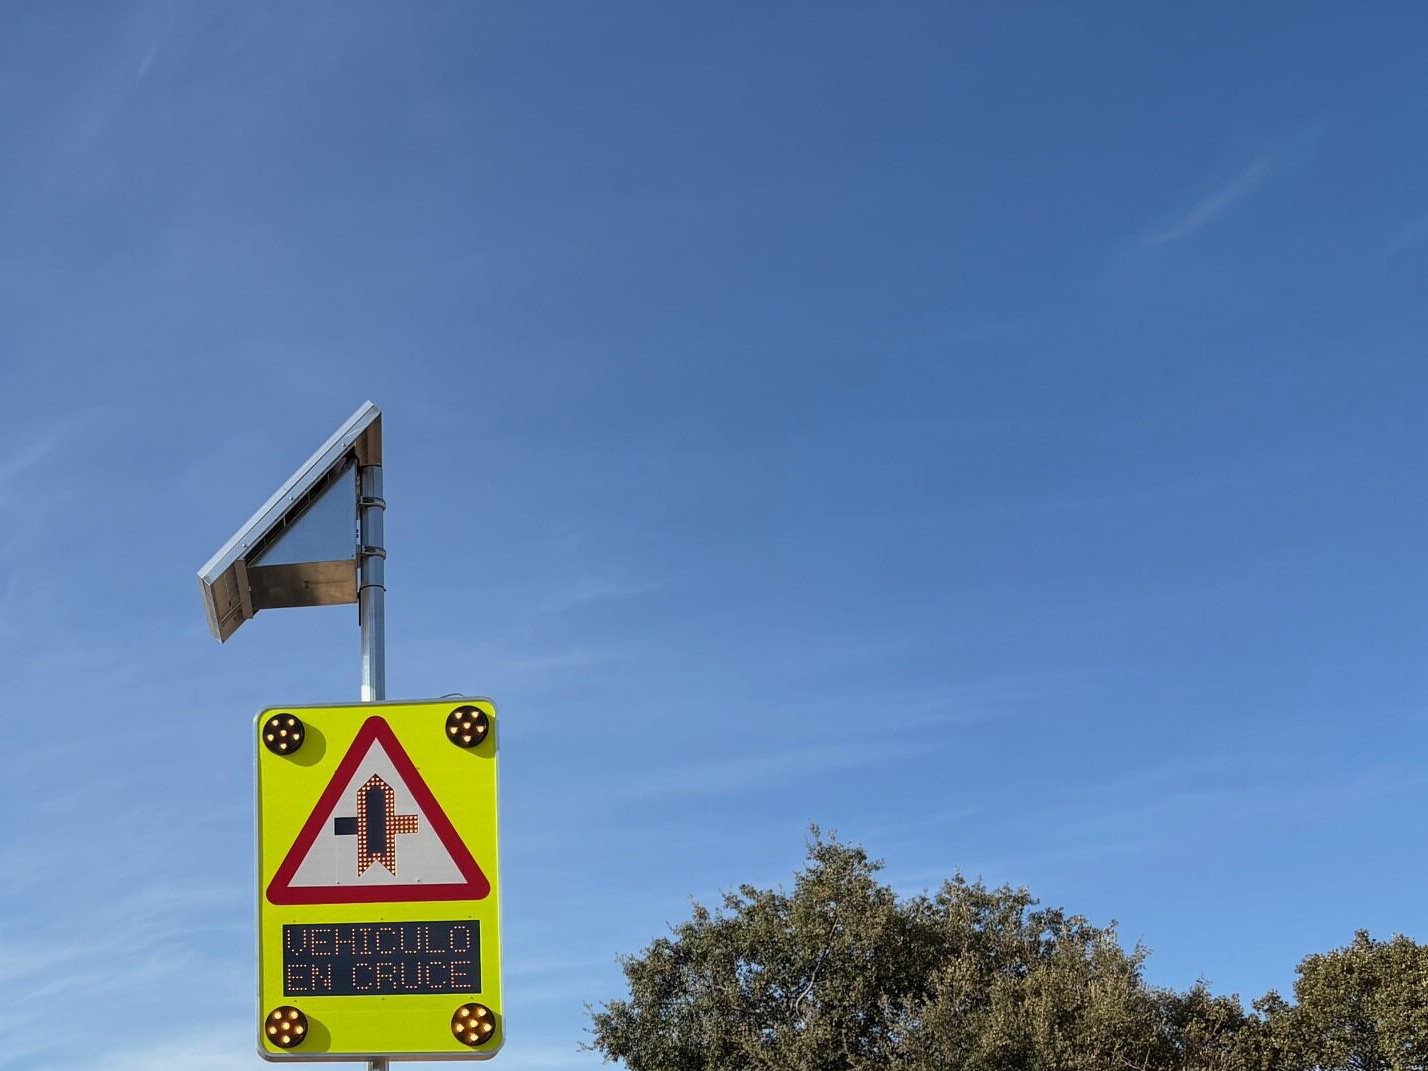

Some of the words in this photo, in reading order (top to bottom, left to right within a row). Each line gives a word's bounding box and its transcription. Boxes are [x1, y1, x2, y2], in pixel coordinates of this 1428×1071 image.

[287, 926, 471, 956] VEHICULO
[288, 963, 332, 990] EN
[352, 961, 471, 989] CRUCE
